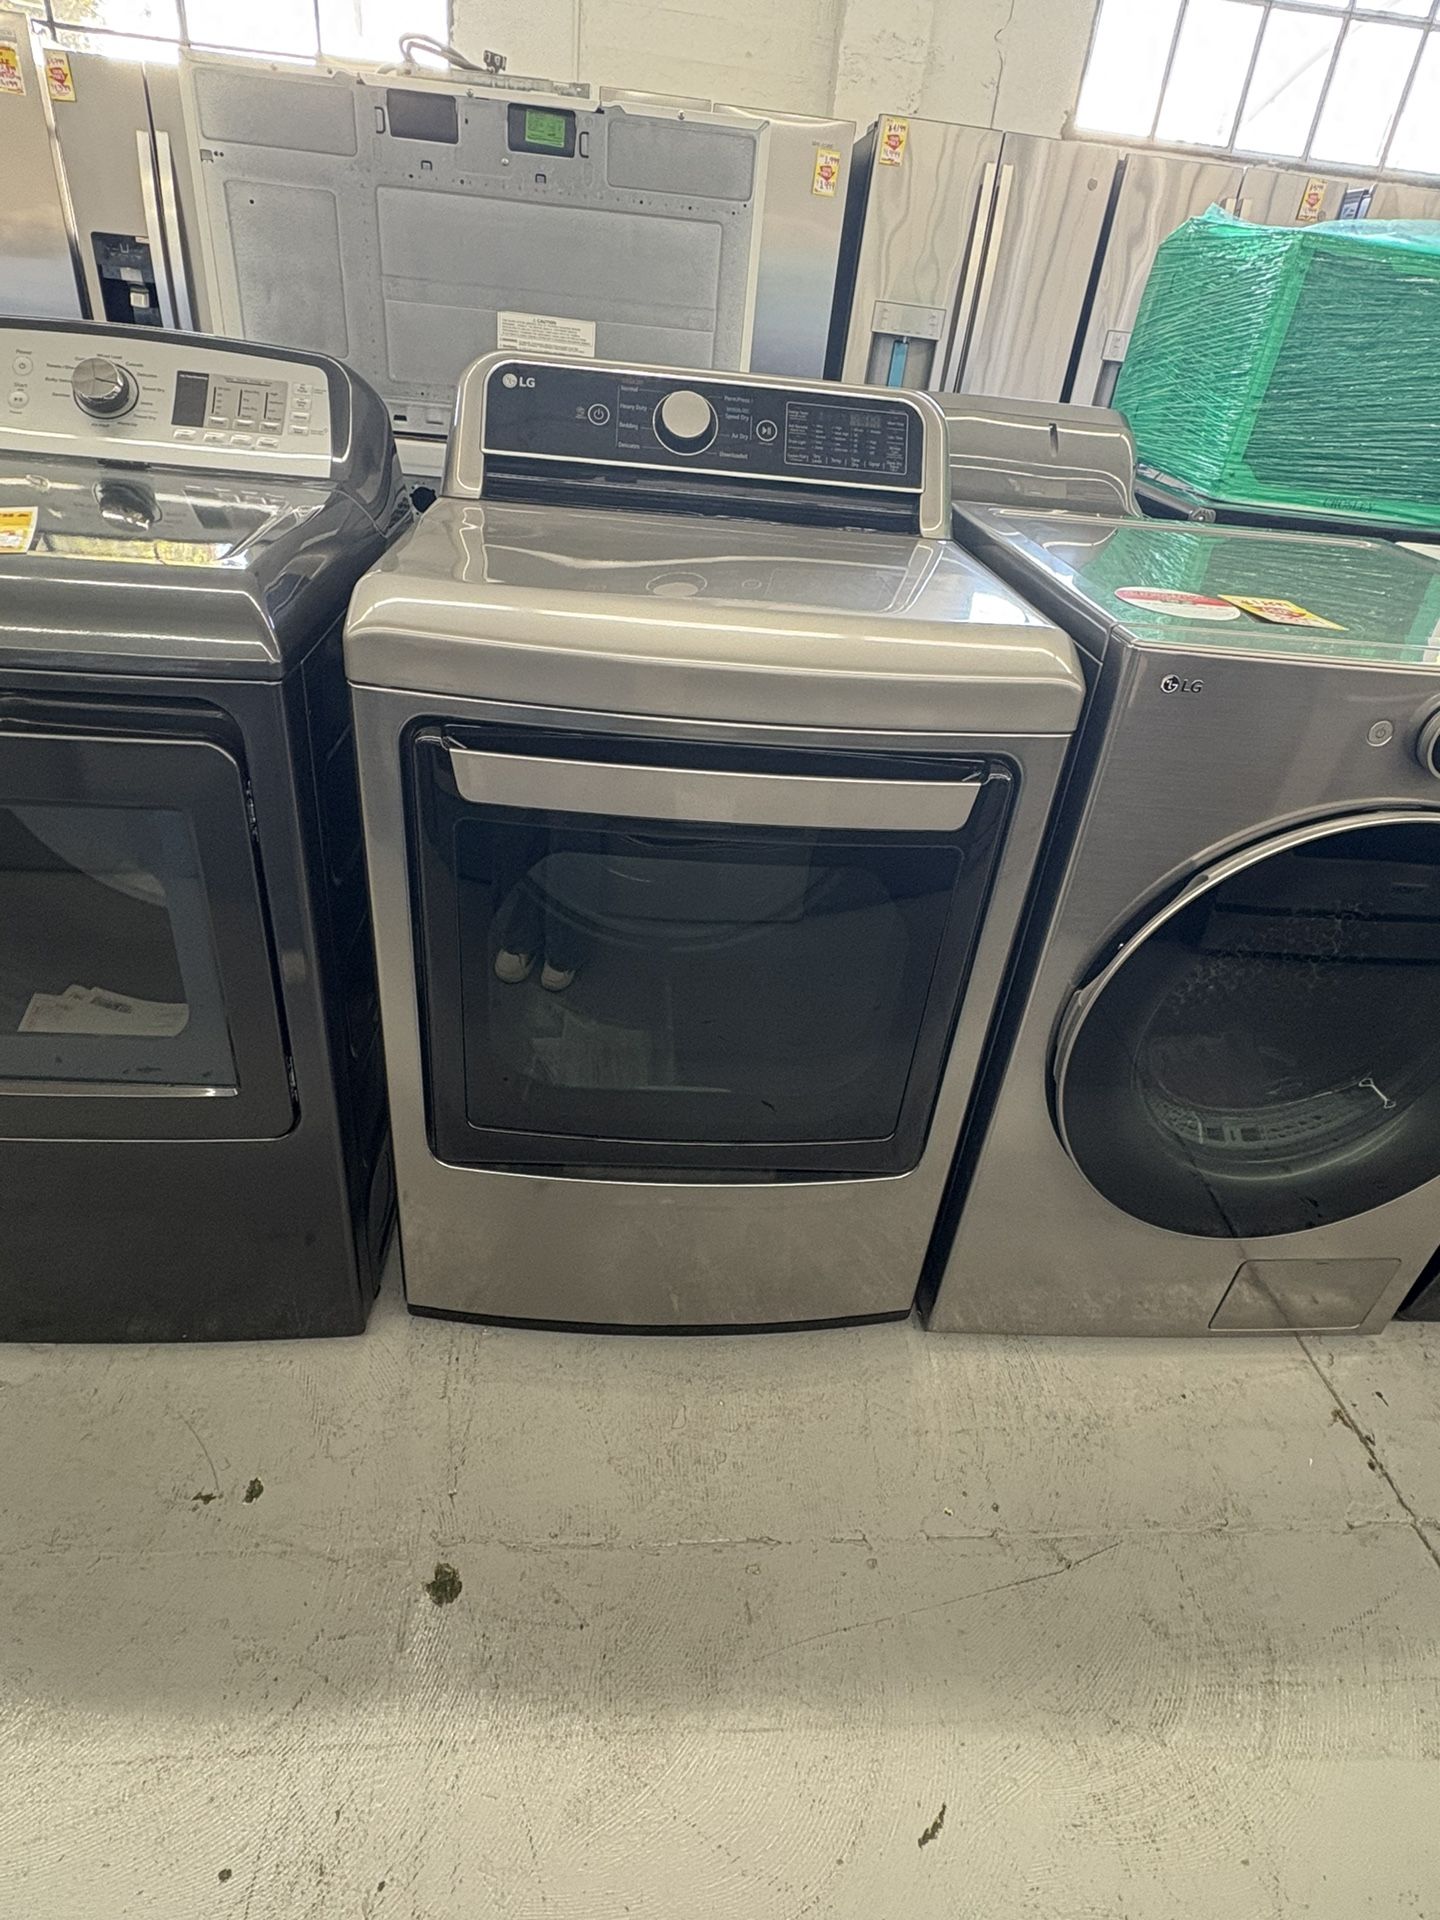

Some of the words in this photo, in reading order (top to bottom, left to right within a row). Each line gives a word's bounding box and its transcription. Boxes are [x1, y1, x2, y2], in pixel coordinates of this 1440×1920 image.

[519, 376, 536, 388] LG
[619, 403, 635, 411] Heavy
[635, 404, 648, 412] Duty
[740, 414, 750, 422] Dry
[740, 433, 749, 441] Dry
[1181, 679, 1204, 693] LG
